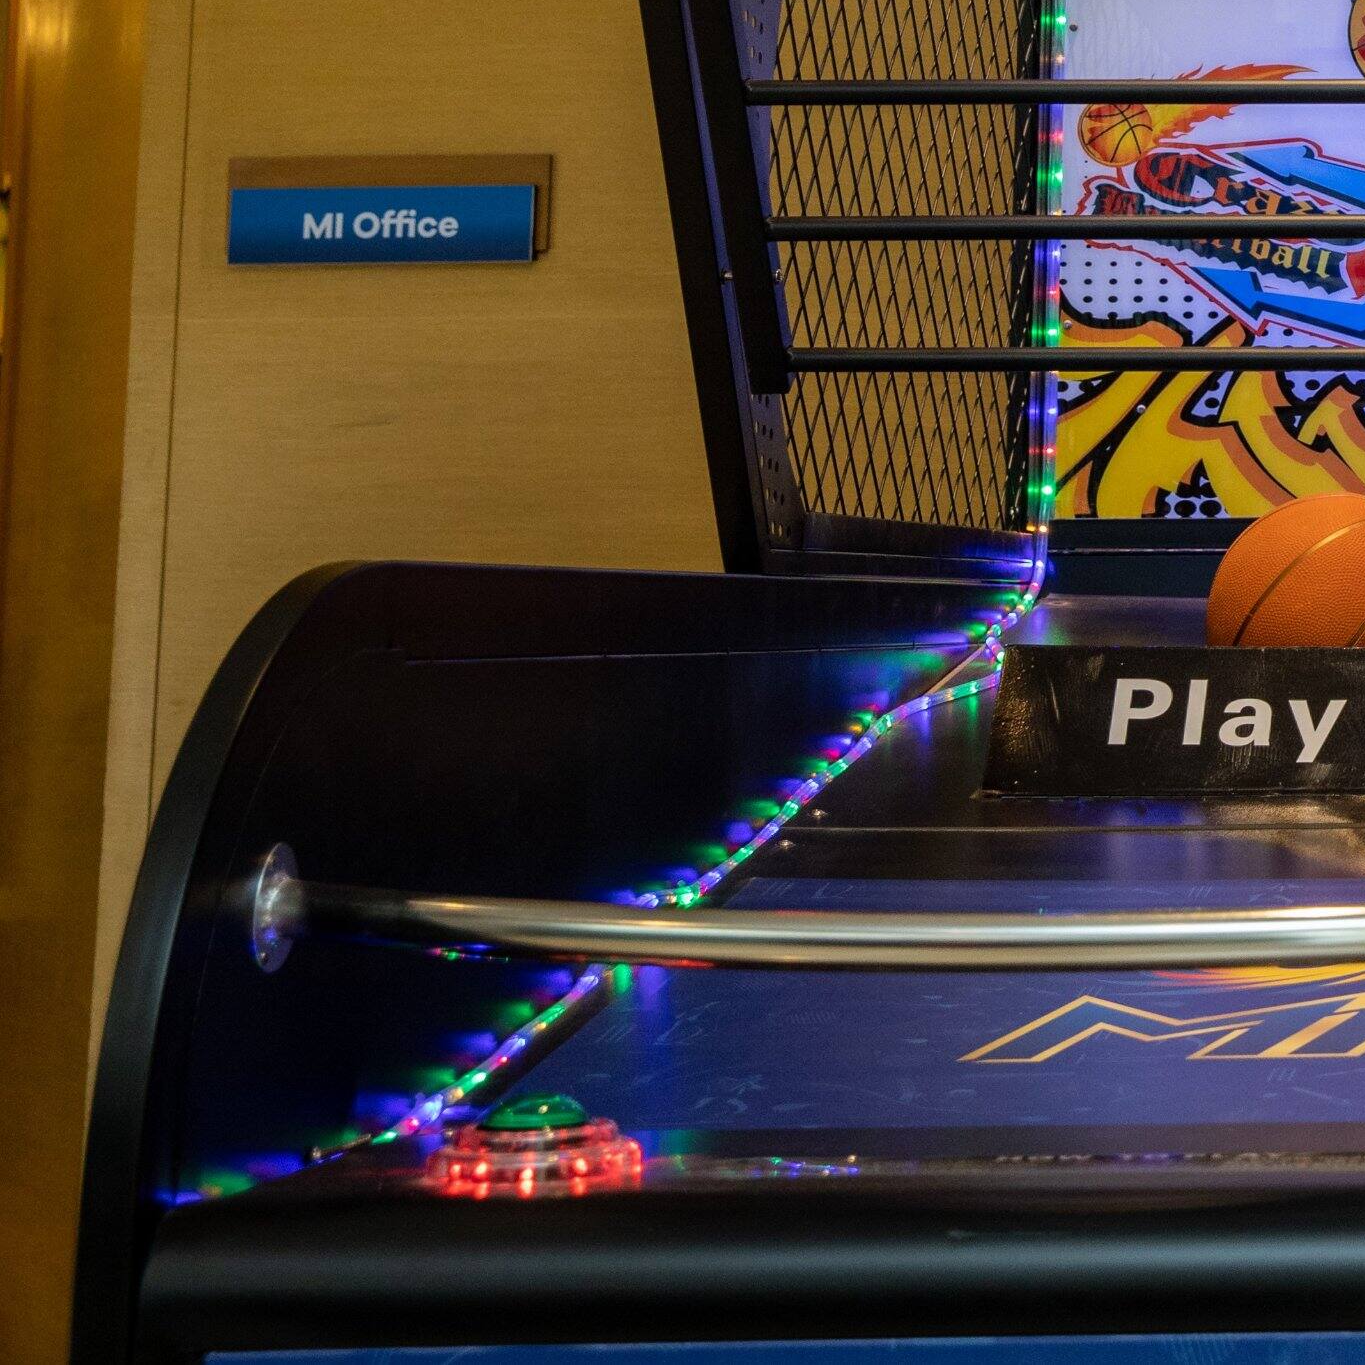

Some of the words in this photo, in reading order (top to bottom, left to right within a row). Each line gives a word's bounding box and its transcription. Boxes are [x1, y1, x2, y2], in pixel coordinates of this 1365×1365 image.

[302, 211, 345, 240] MI
[352, 208, 460, 239] Office
[1106, 678, 1347, 763] Play
